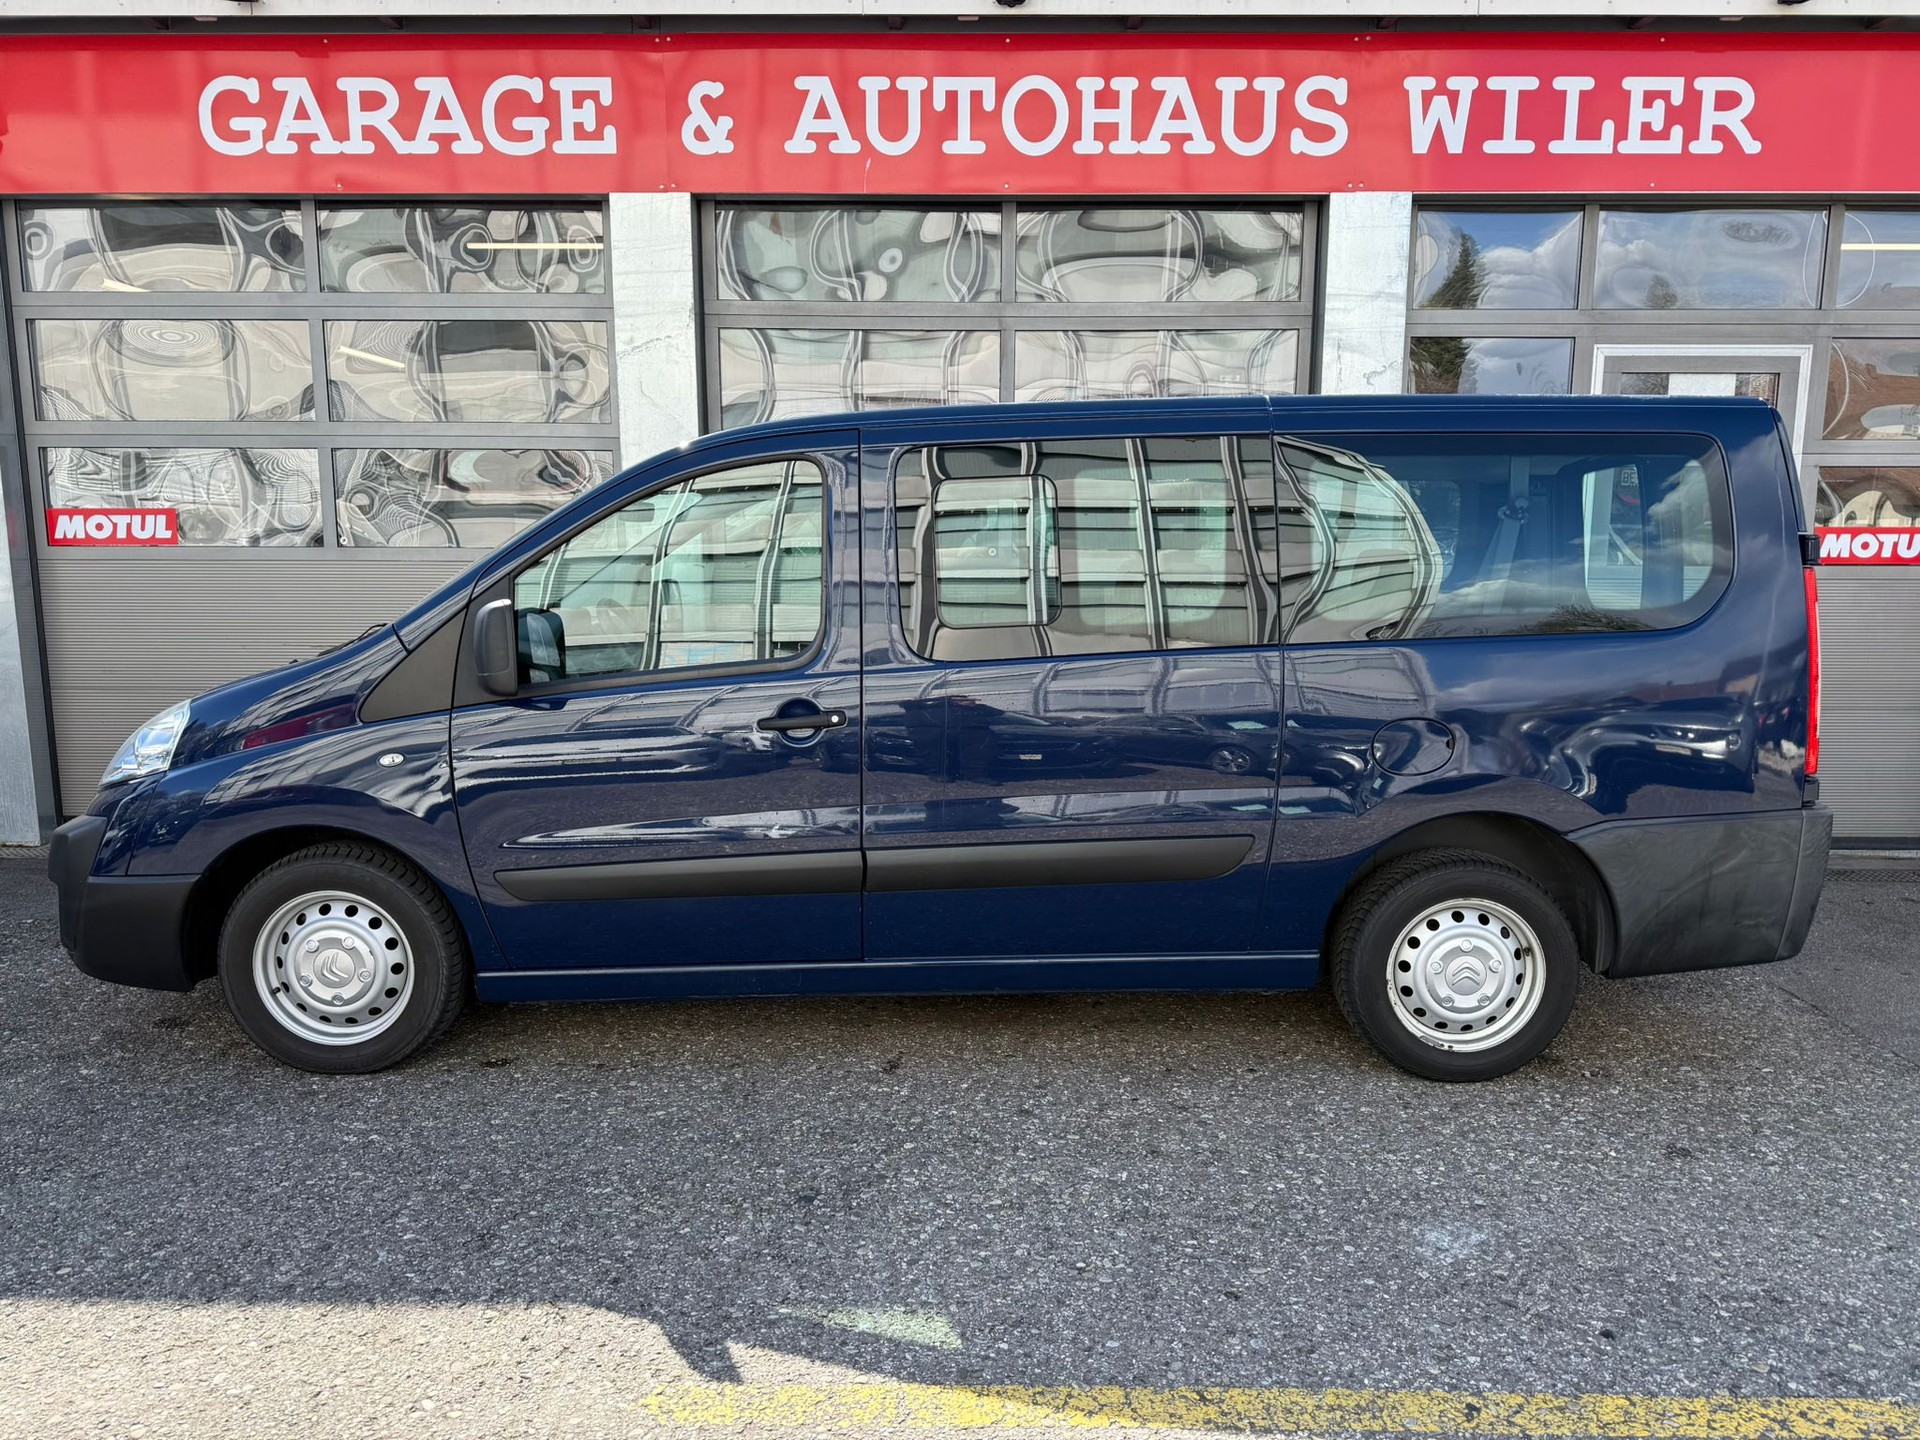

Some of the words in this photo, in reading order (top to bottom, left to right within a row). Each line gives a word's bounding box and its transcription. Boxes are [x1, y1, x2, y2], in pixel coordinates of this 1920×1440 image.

[199, 75, 617, 156] GARAGE
[682, 81, 734, 155] &
[784, 75, 1348, 156] AUTOHAUS
[1404, 76, 1761, 155] WILER
[54, 515, 172, 539] MOTUL
